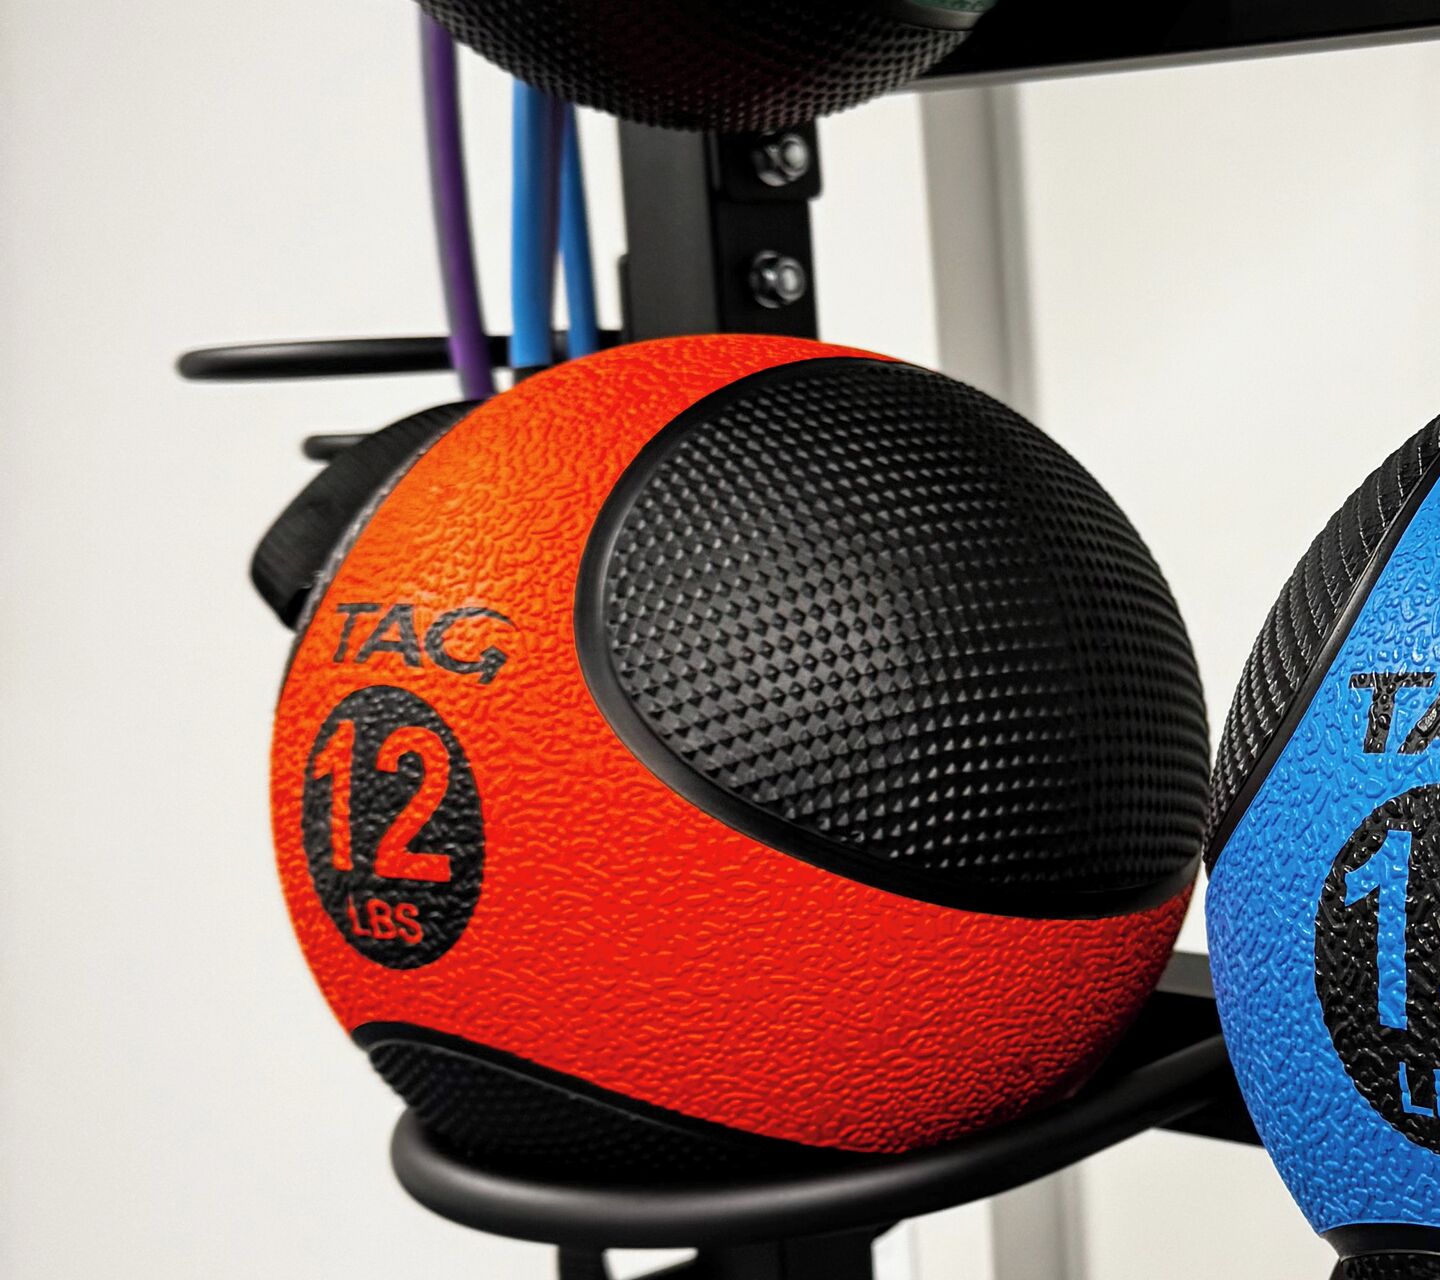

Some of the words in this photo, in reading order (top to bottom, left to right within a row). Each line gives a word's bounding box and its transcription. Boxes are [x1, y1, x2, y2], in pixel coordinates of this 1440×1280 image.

[333, 602, 520, 685] TAG
[312, 719, 451, 882] 12
[347, 894, 424, 945] LBS
